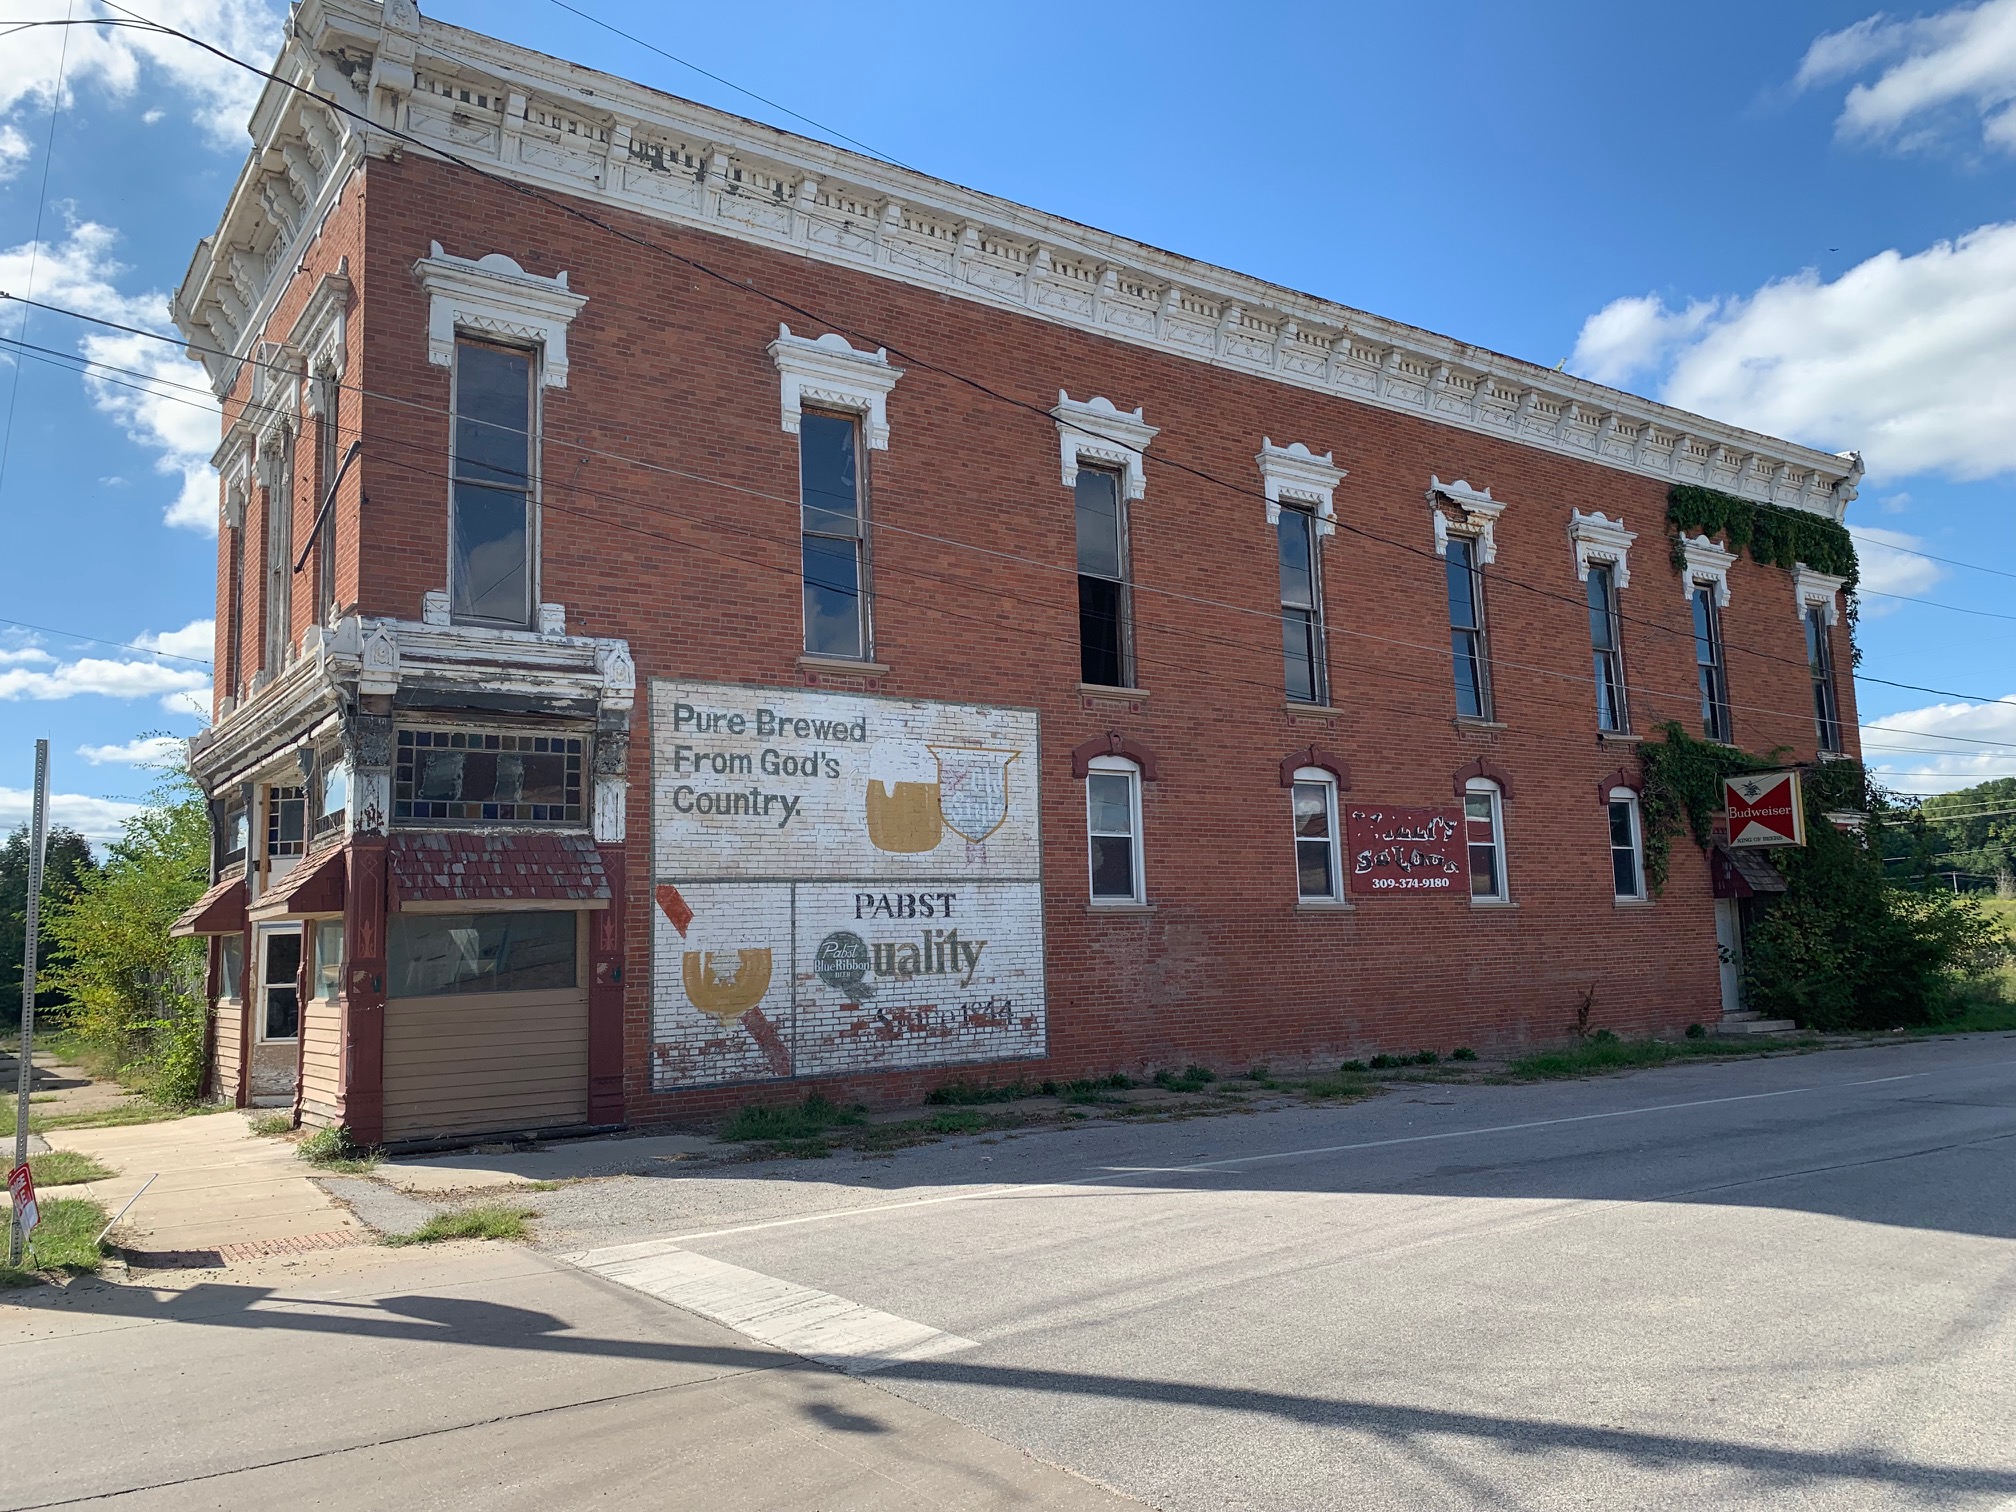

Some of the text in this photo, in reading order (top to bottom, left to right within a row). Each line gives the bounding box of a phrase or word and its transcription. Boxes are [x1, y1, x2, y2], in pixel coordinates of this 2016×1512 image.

[673, 703, 866, 742] Pure Brewed
[674, 745, 840, 779] From God's
[673, 785, 801, 829] Country.
[1728, 806, 1791, 819] Budweiser
[1372, 877, 1450, 889] 309-374-9180
[854, 892, 957, 919] PABST
[821, 941, 859, 959] Pabst
